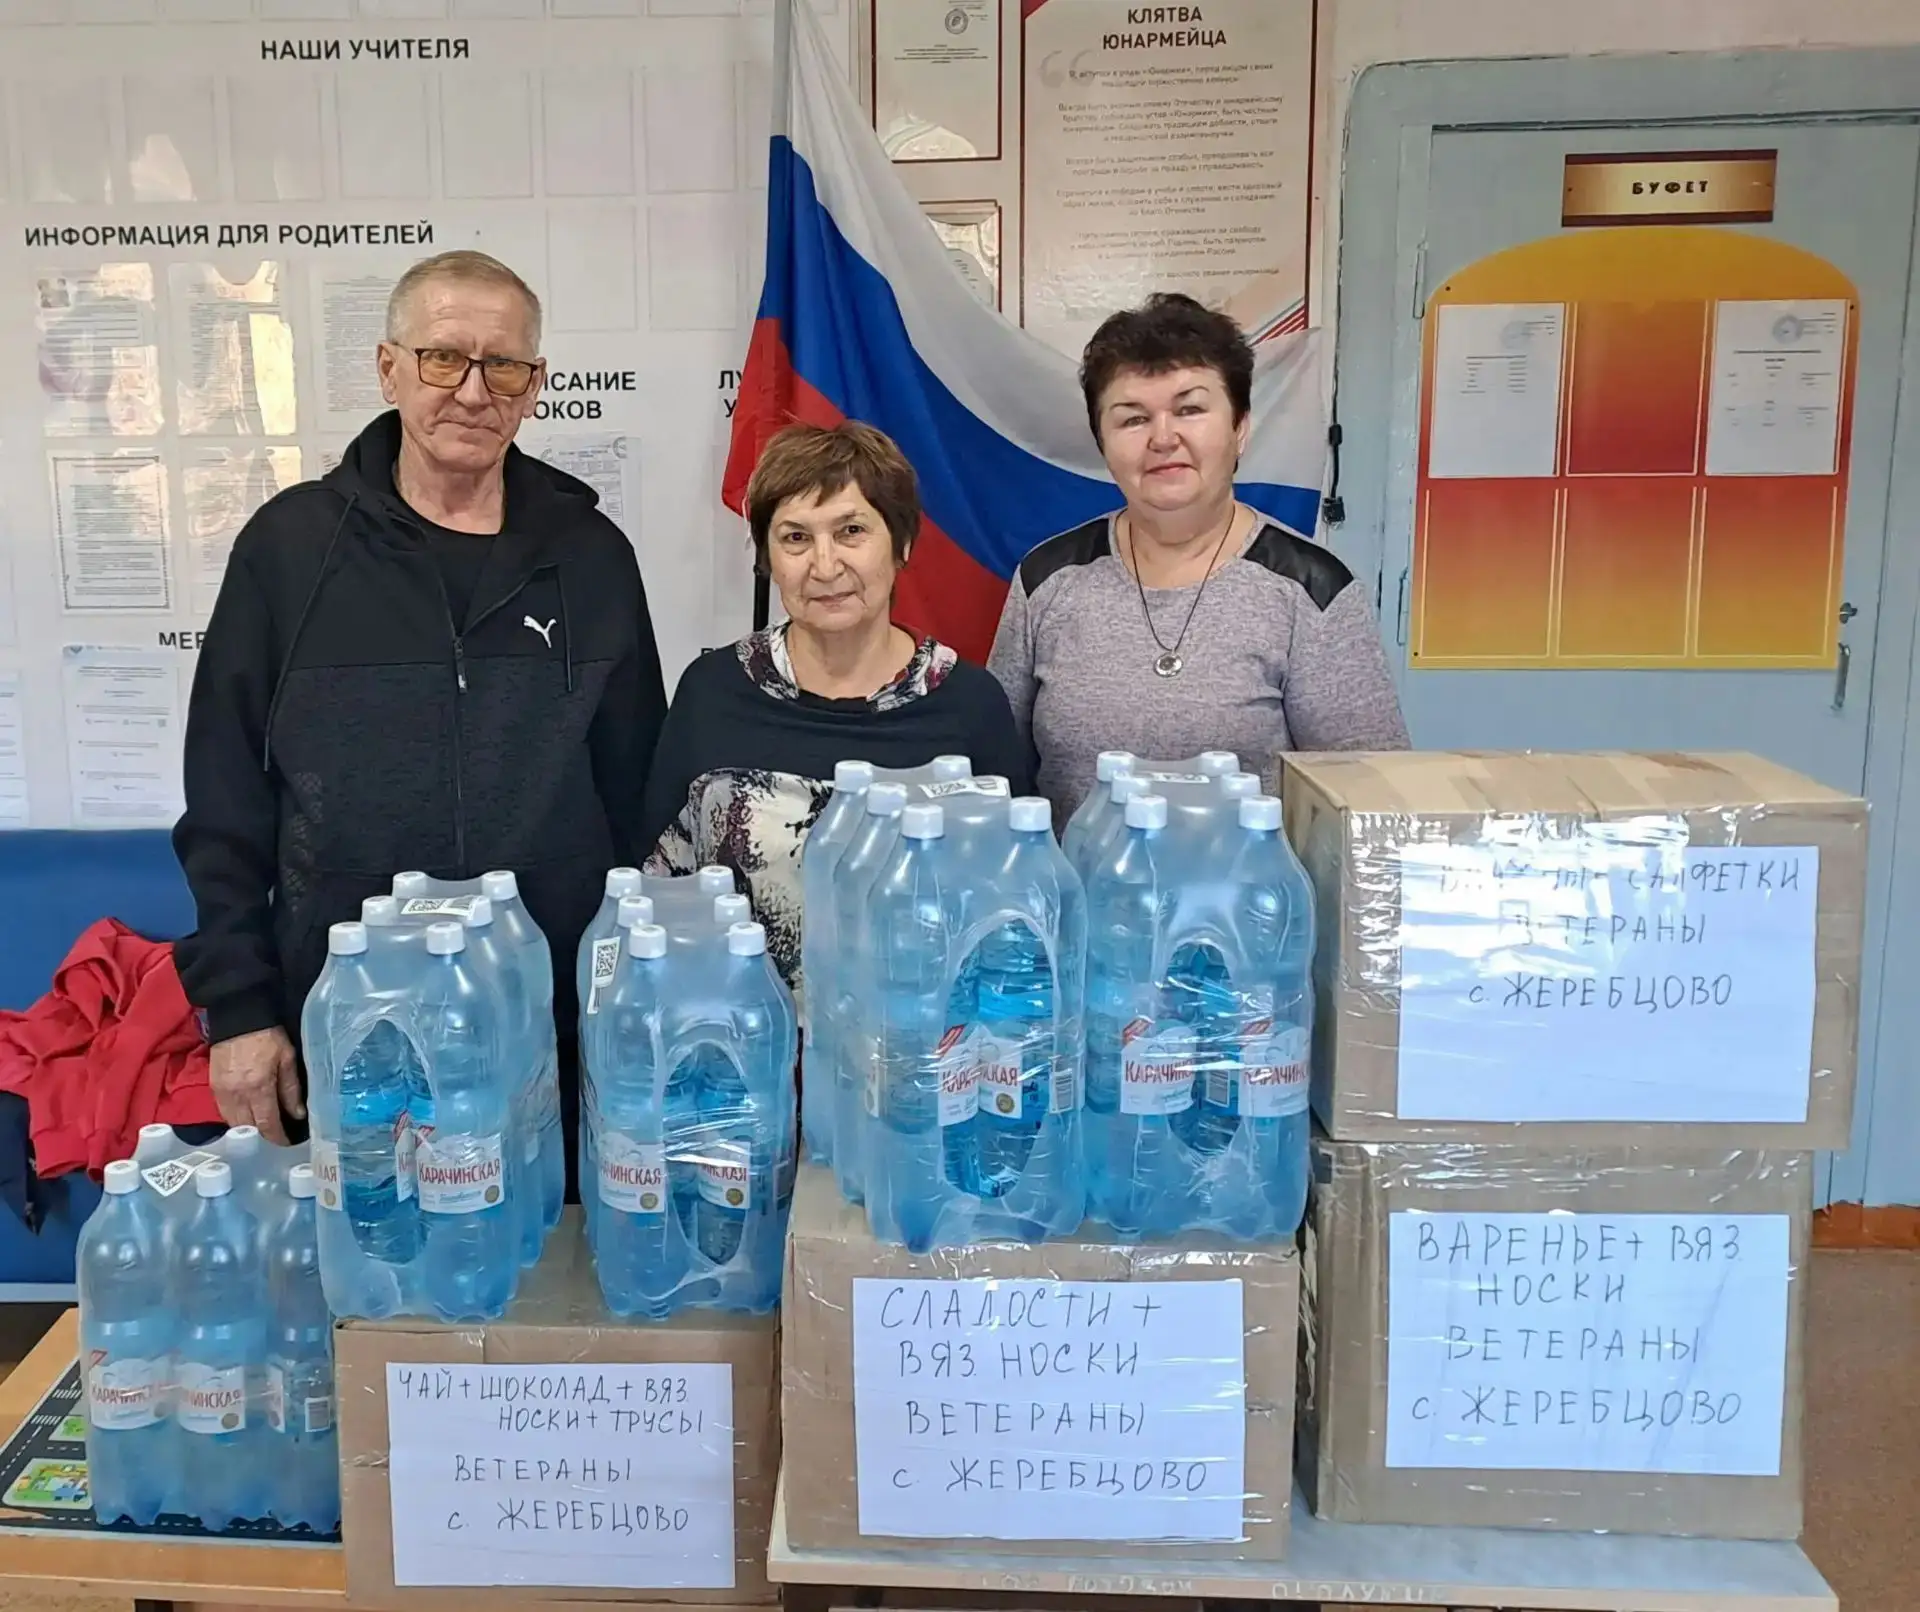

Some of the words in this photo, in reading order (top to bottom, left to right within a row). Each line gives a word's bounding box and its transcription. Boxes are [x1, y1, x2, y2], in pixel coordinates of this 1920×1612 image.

[1127, 6, 1203, 25] КЛЯТВА
[260, 40, 341, 61] НАШИ
[349, 38, 470, 61] УЧИТЕЛЯ
[1101, 26, 1228, 51] ЮНАРМЕЙЦА
[1631, 180, 1709, 195] БУФЕТ
[24, 224, 210, 249] ИНФОРМАЦИЯ
[217, 223, 269, 249] ДЛЯ
[278, 219, 434, 248] РОДИТЕЛЕЙ
[543, 371, 637, 392] САНИЕ
[1503, 972, 1733, 1014] ЖЕРЕБЦОВО
[419, 1158, 500, 1184] КАРАЧИНСКАЯ
[1476, 1272, 1625, 1306] НОСКИ
[880, 1286, 1113, 1329] СЛАДОСТИ
[1000, 1341, 1139, 1379] НОСКИ
[1447, 1325, 1699, 1362] ВЕТЕРАНЫ
[907, 1400, 1145, 1437] ВЕТЕРАНЫ
[1461, 1386, 1741, 1432] ЖЕРЕБЦОВО
[454, 1453, 632, 1483] ВЕТЕРАНЫ
[945, 1457, 1207, 1496] ЖЕРЕБЦОВО
[497, 1497, 690, 1537] ЖЕРЕБЦОВО
